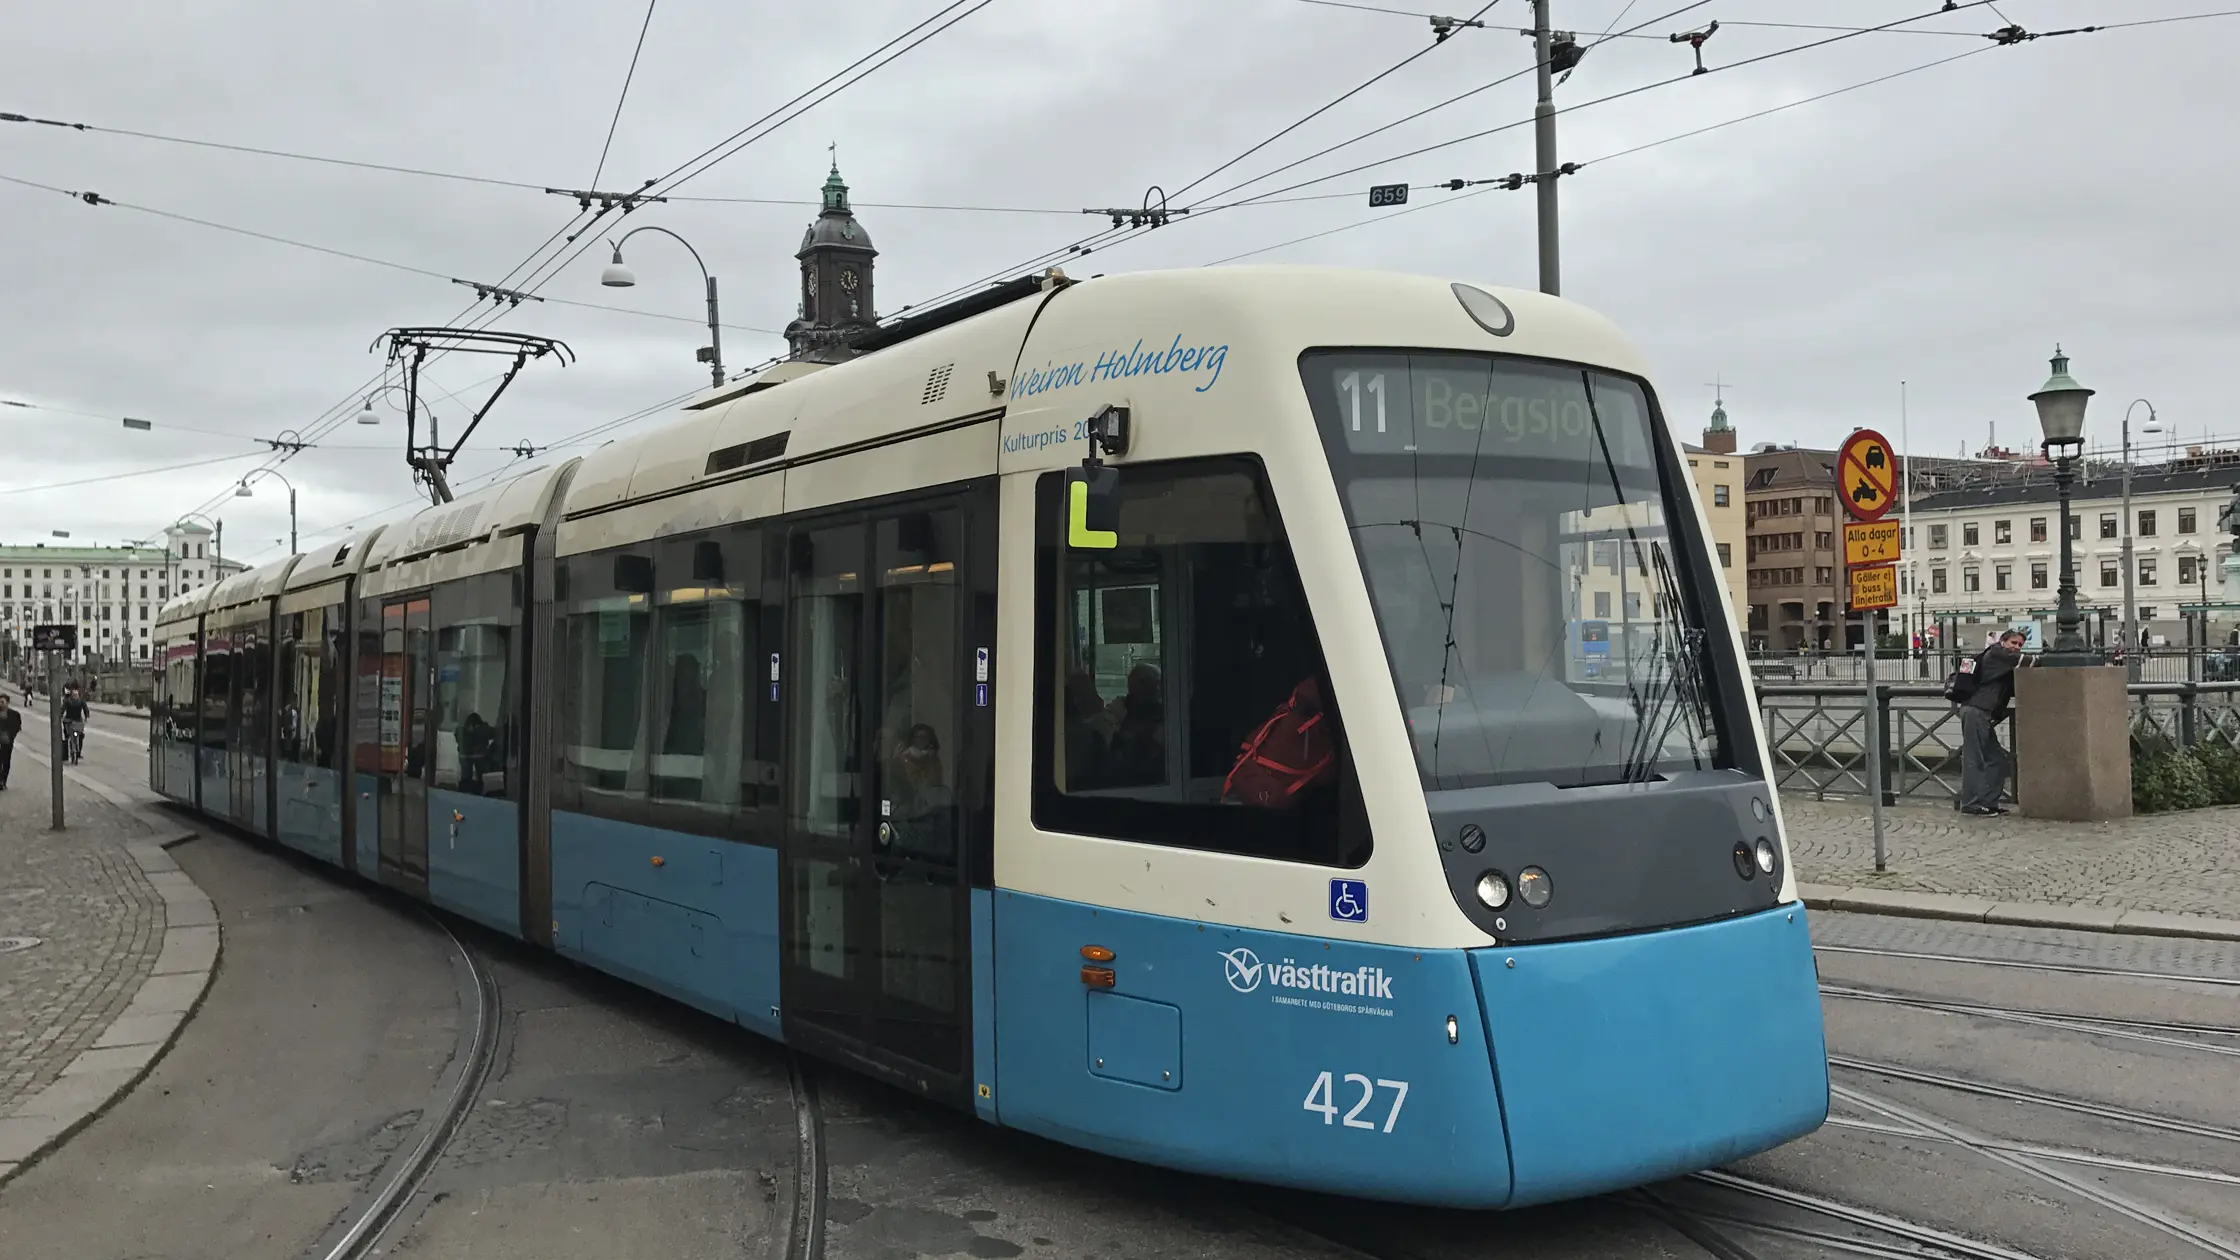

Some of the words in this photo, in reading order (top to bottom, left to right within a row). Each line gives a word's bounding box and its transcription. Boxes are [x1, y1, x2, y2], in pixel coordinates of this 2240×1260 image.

[1371, 187, 1407, 204] 659
[1010, 361, 1088, 401] Weiron
[1090, 333, 1229, 393] Holmberg
[1341, 370, 1386, 433] 11
[1003, 424, 1067, 454] Kulturpris
[1848, 529, 1866, 543] Alla
[1869, 527, 1896, 542] dagar
[1856, 571, 1880, 583] Gäller
[1883, 569, 1891, 582] ej
[1855, 590, 1893, 605] linjetrafik
[1862, 584, 1881, 594] buss
[1267, 957, 1394, 999] västtrafik
[1275, 995, 1308, 1008] SAMARBETE
[1308, 1000, 1321, 1009] MED
[1357, 1005, 1394, 1017] SPÅRVÄGAR
[1303, 1070, 1409, 1134] 427
